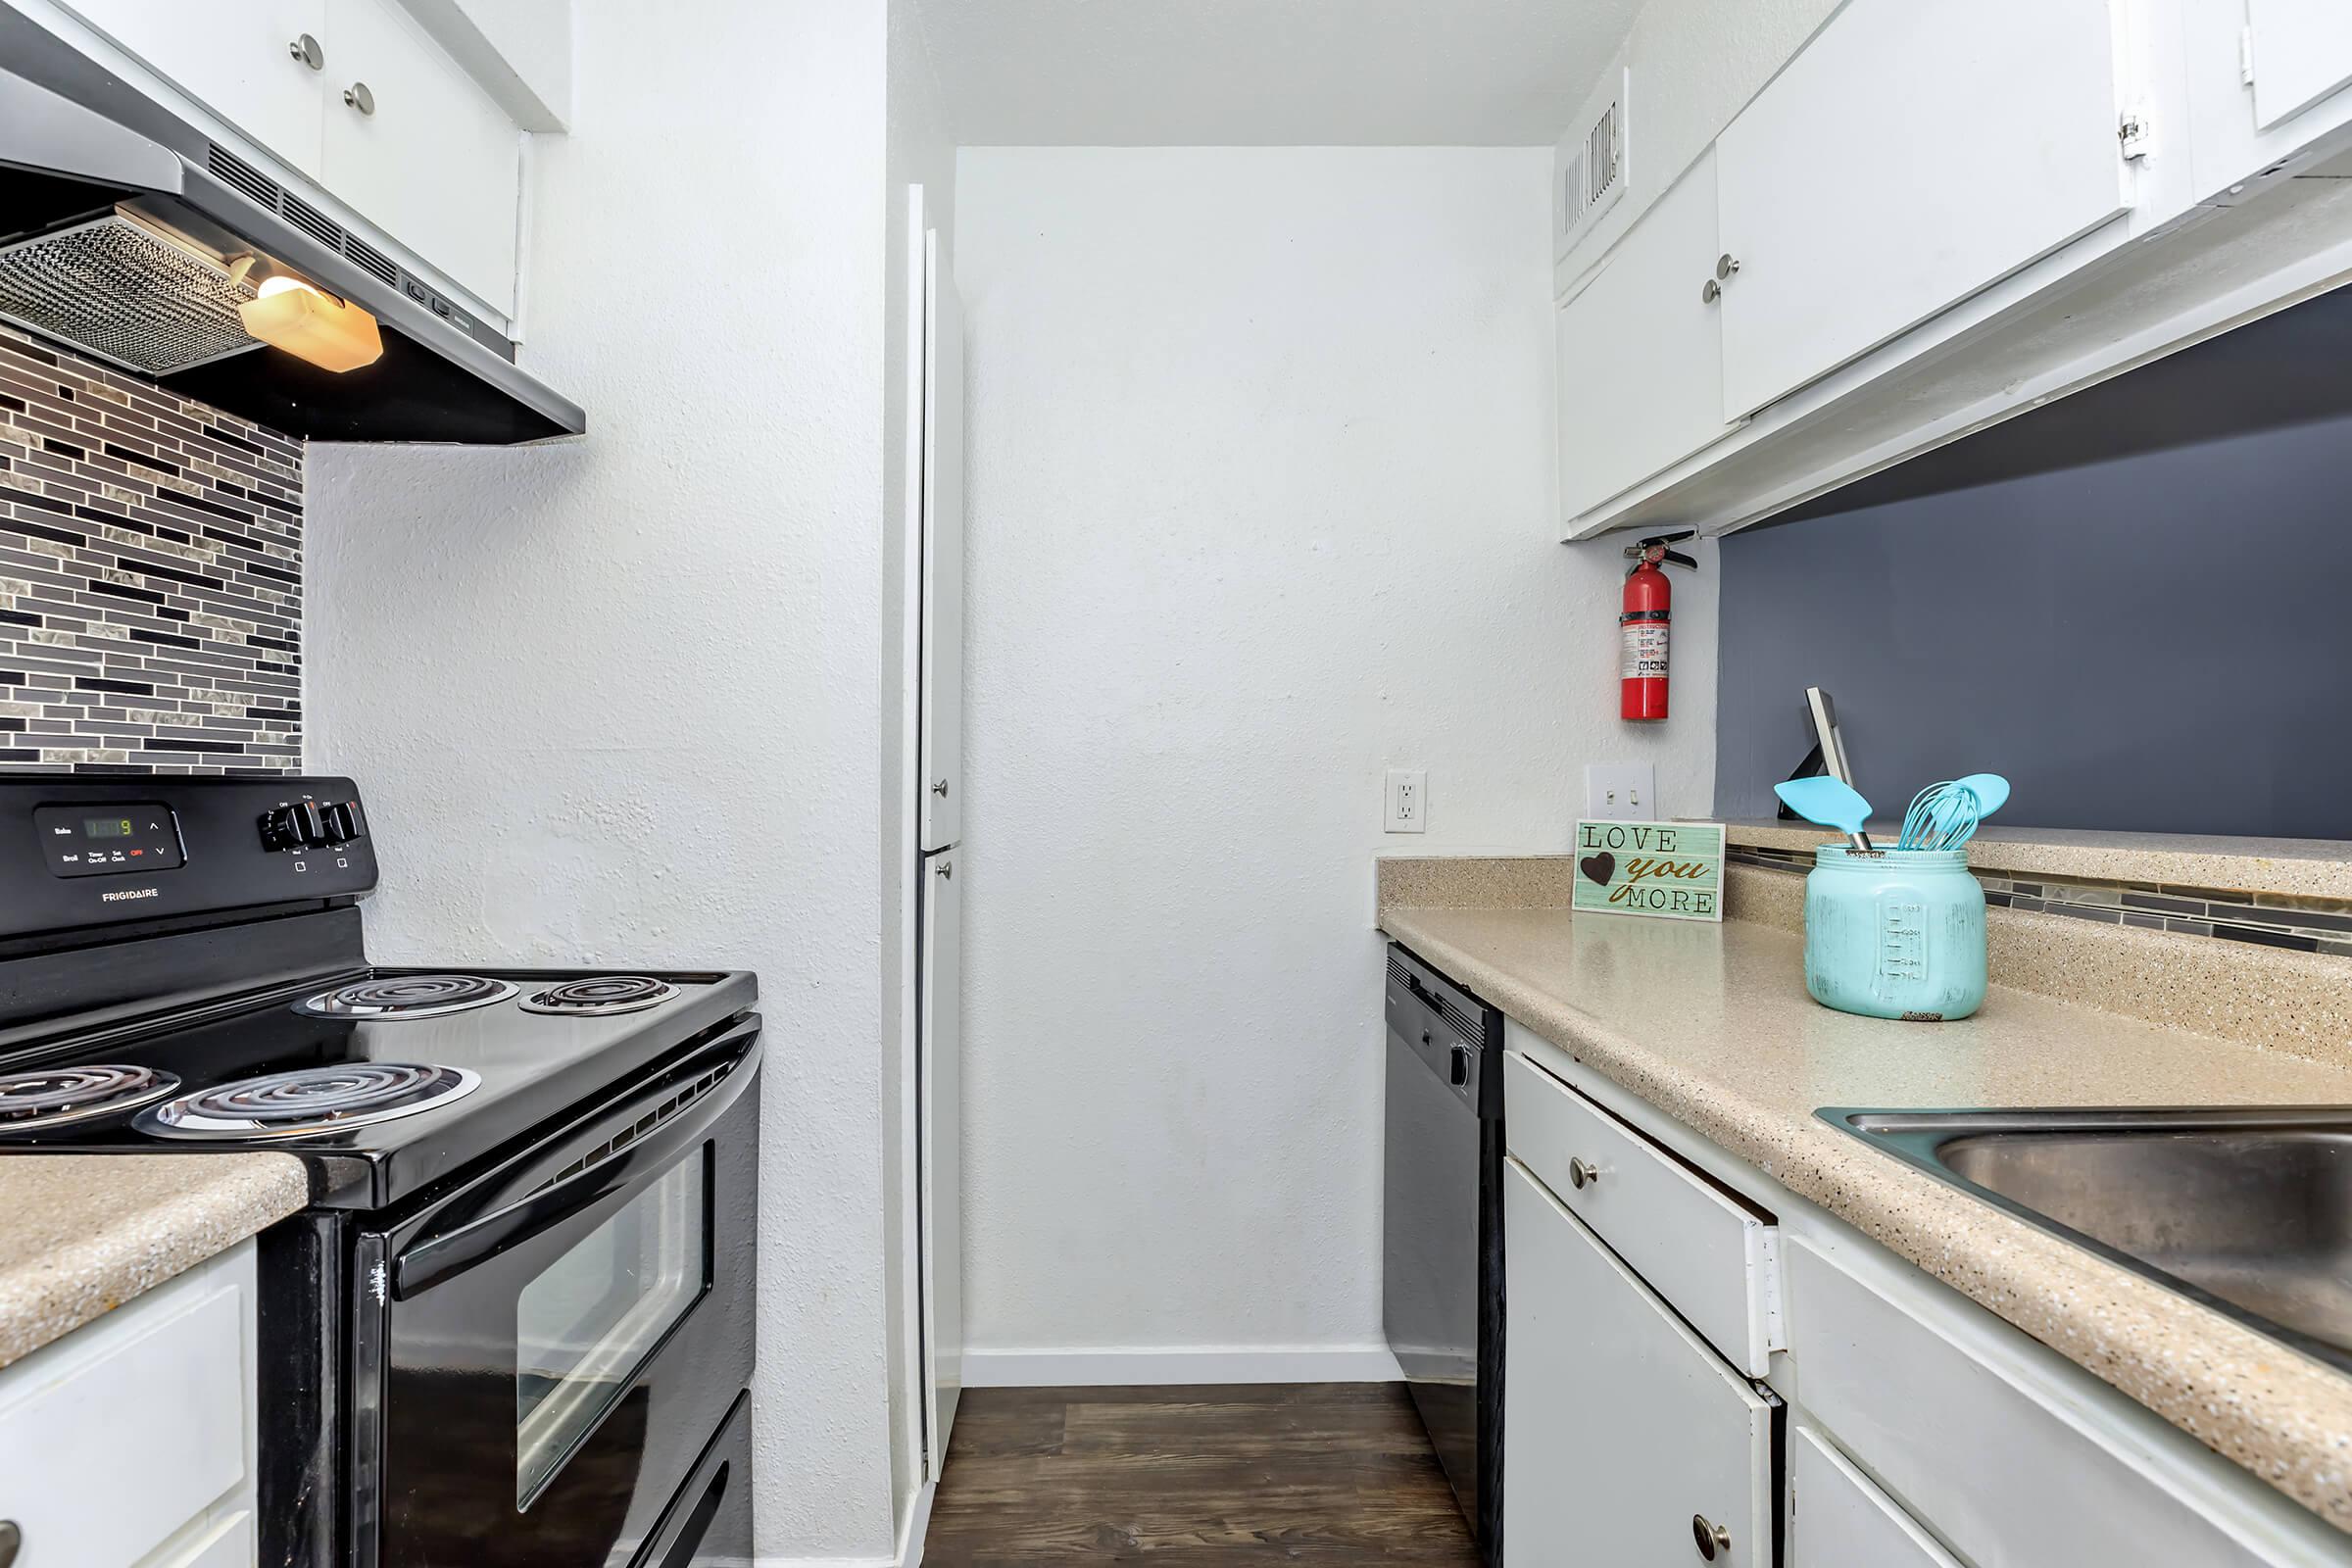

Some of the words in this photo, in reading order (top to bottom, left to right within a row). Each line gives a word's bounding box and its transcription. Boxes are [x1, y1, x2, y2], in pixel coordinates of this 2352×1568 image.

[1583, 825, 1677, 853] LOVE
[1608, 857, 1710, 903] you
[102, 888, 159, 903] FRIGIDAIRE
[1627, 888, 1712, 913] MORE
